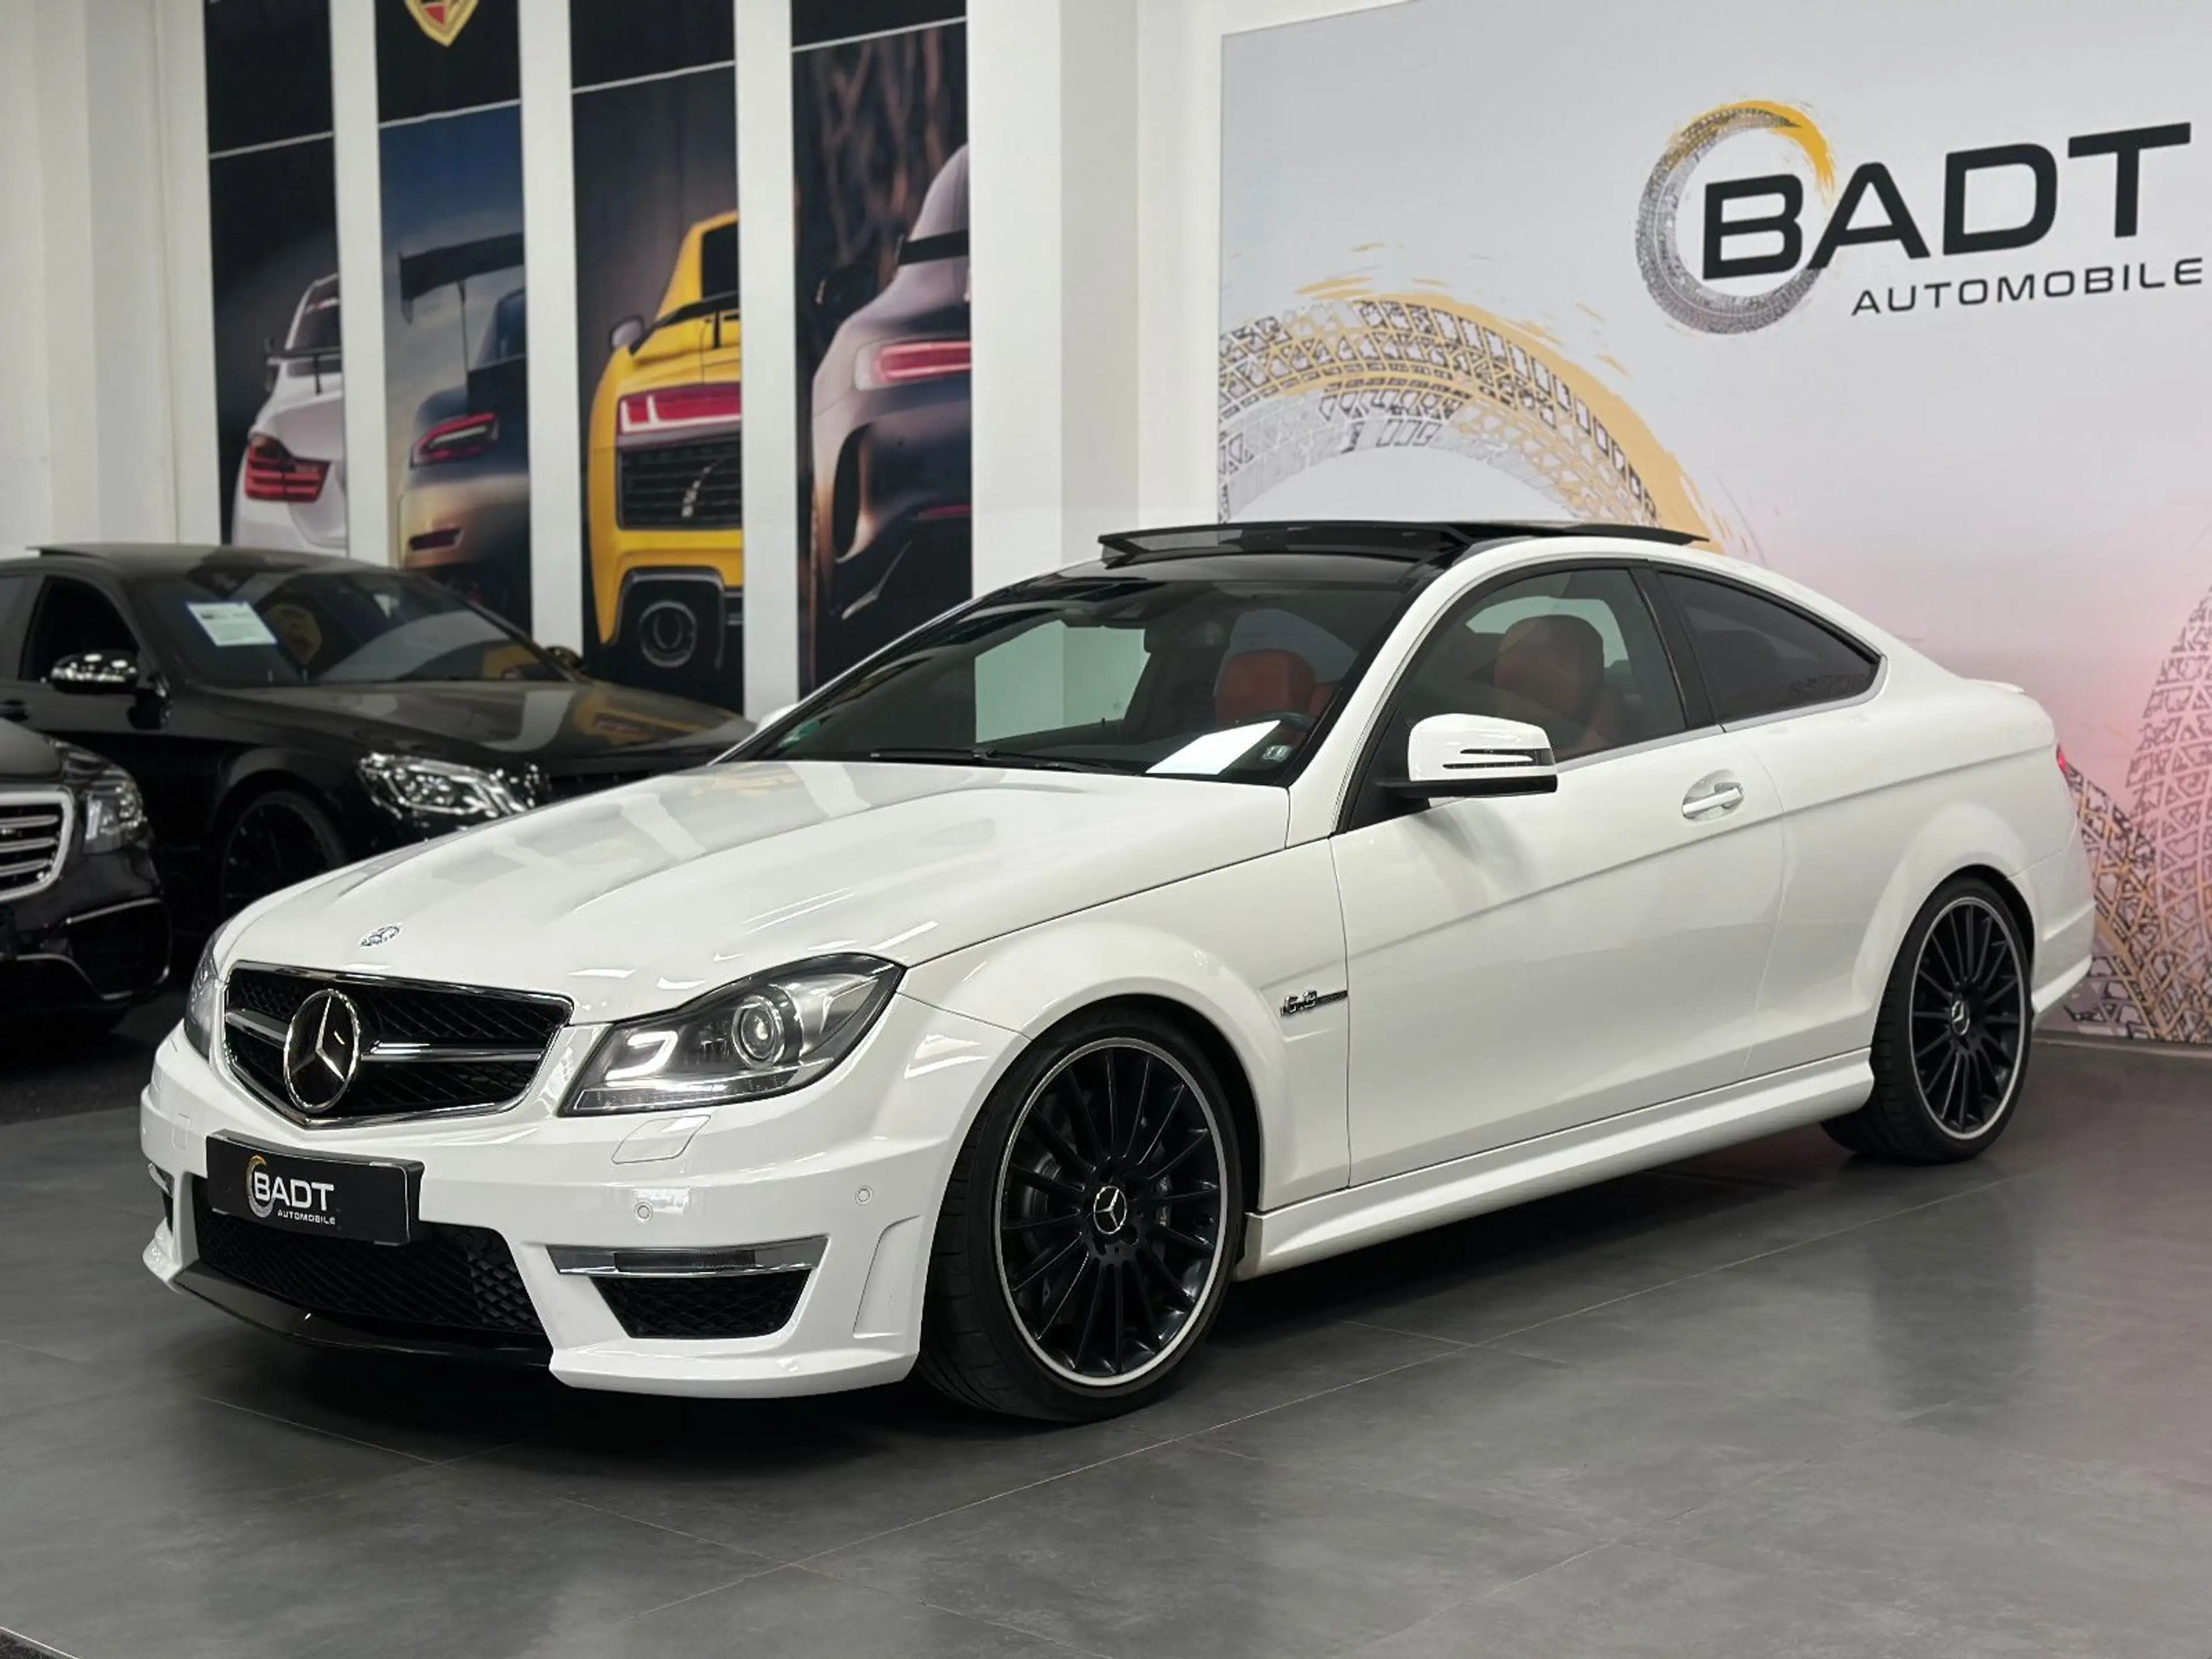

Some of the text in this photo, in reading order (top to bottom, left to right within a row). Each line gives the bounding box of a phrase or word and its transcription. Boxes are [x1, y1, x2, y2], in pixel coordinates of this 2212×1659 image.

[1702, 122, 2191, 281] BADT
[1852, 257, 2202, 316] AUTOMOBILE
[254, 1171, 335, 1211] BADT
[277, 1209, 336, 1225] AUTOMOBILE
